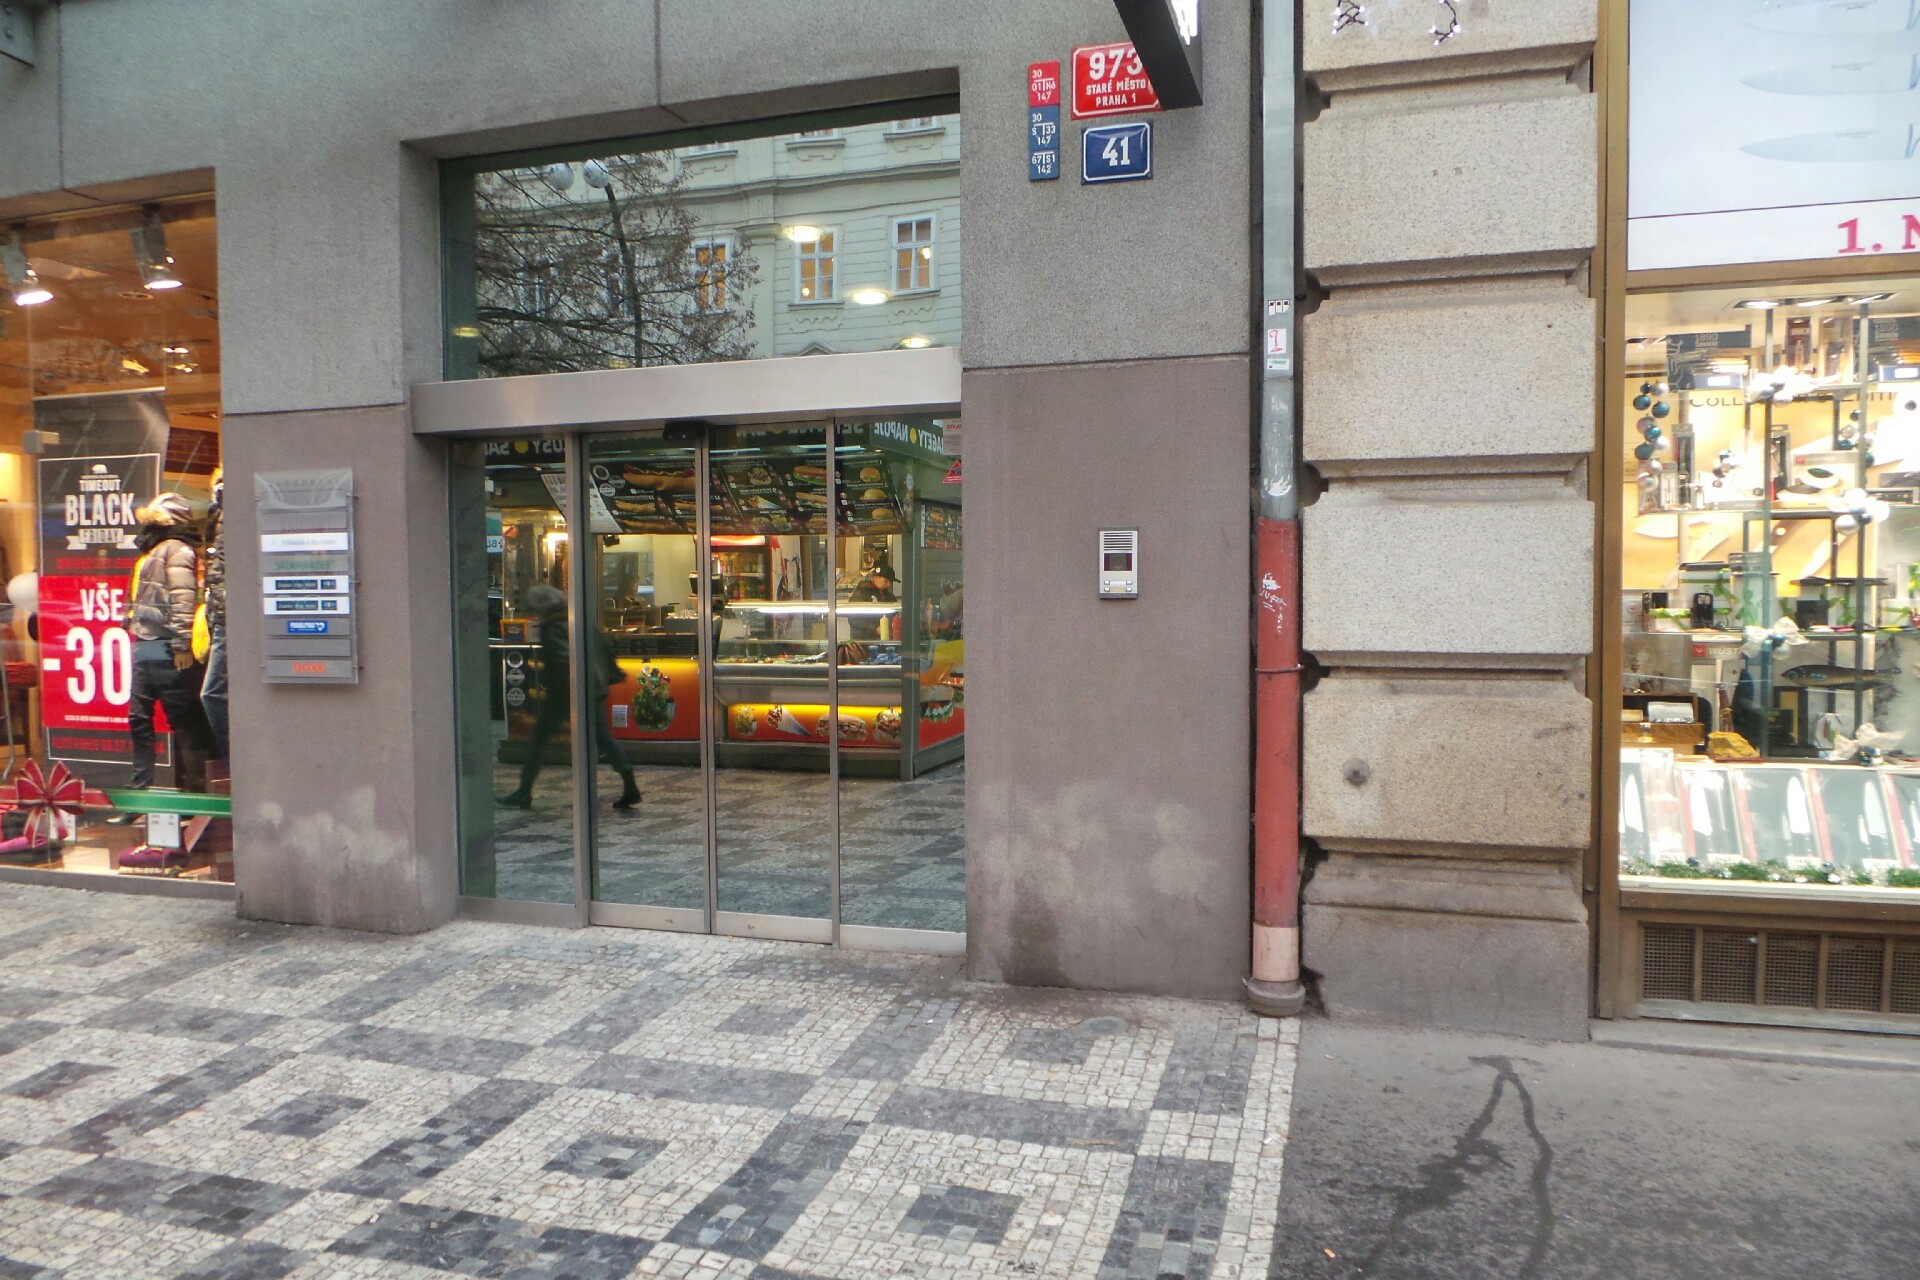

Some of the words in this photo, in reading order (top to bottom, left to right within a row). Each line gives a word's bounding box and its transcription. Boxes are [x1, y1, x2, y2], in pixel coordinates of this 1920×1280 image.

[1032, 69, 1042, 79] 30
[1090, 47, 1143, 80] 973
[1086, 79, 1112, 96] STARÉ
[1116, 77, 1146, 92] MĚSTO
[1096, 94, 1127, 108] PRAHA
[1131, 92, 1136, 104] 1
[1032, 113, 1042, 123] 30
[1102, 136, 1131, 167] 41
[1838, 217, 1883, 254] 1.
[65, 492, 136, 526] BLACK
[82, 528, 123, 543] FRIDAY
[80, 582, 124, 622] VŠE
